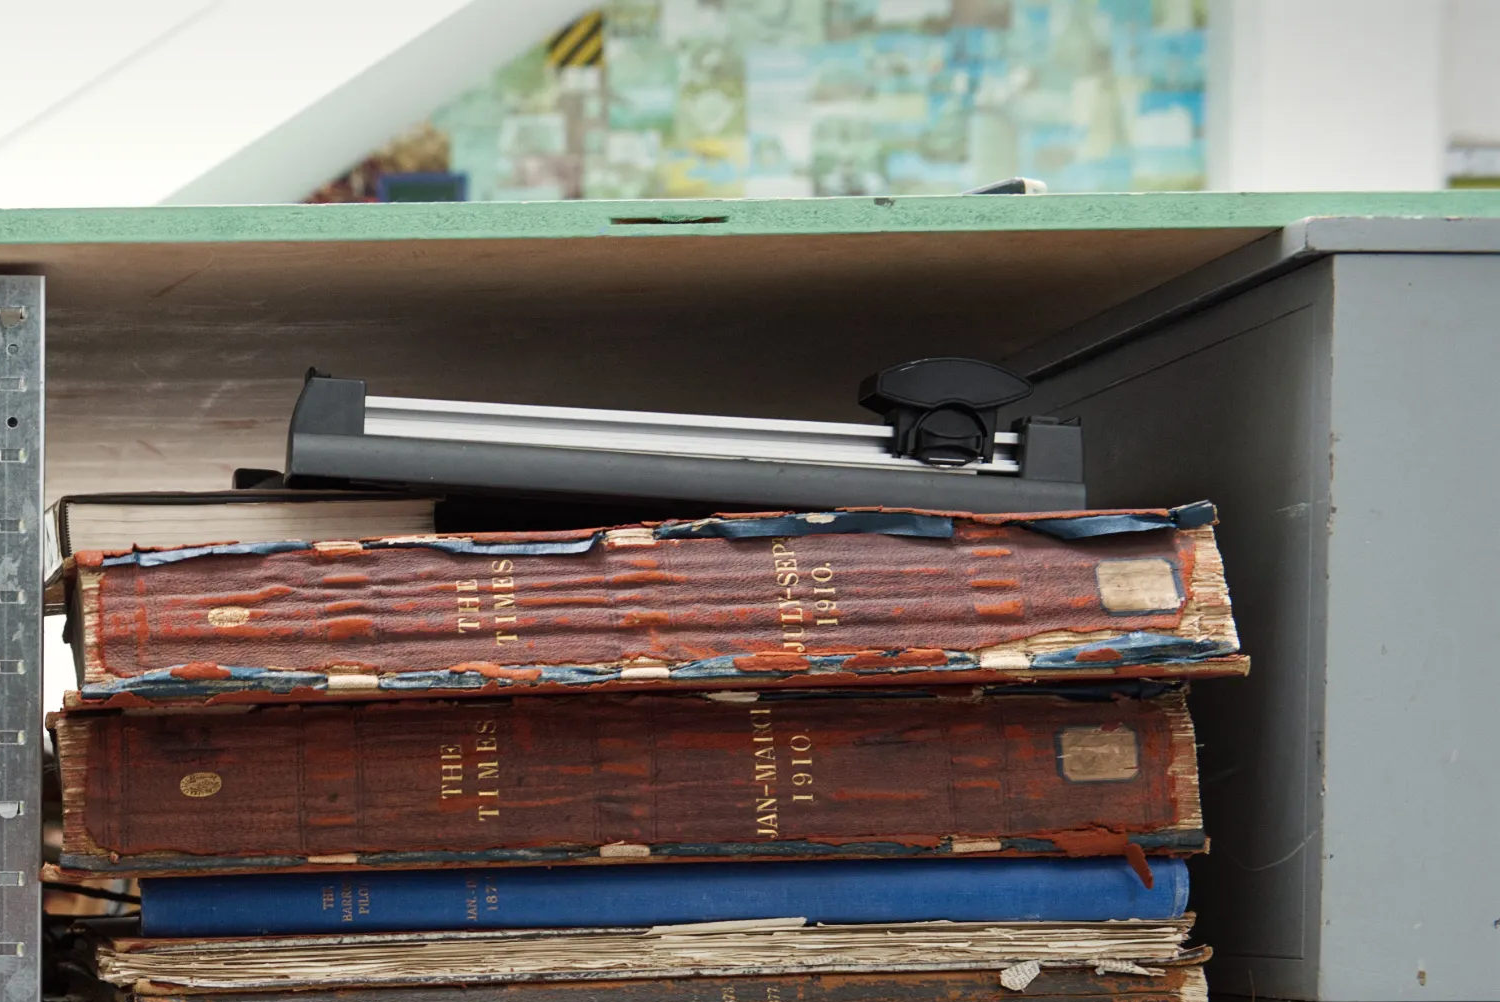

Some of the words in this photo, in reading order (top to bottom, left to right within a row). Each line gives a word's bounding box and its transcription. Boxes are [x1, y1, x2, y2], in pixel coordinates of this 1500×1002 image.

[456, 579, 480, 634] THE
[491, 559, 519, 646] TIMES
[440, 743, 463, 800] THE
[475, 720, 500, 821] TIMES
